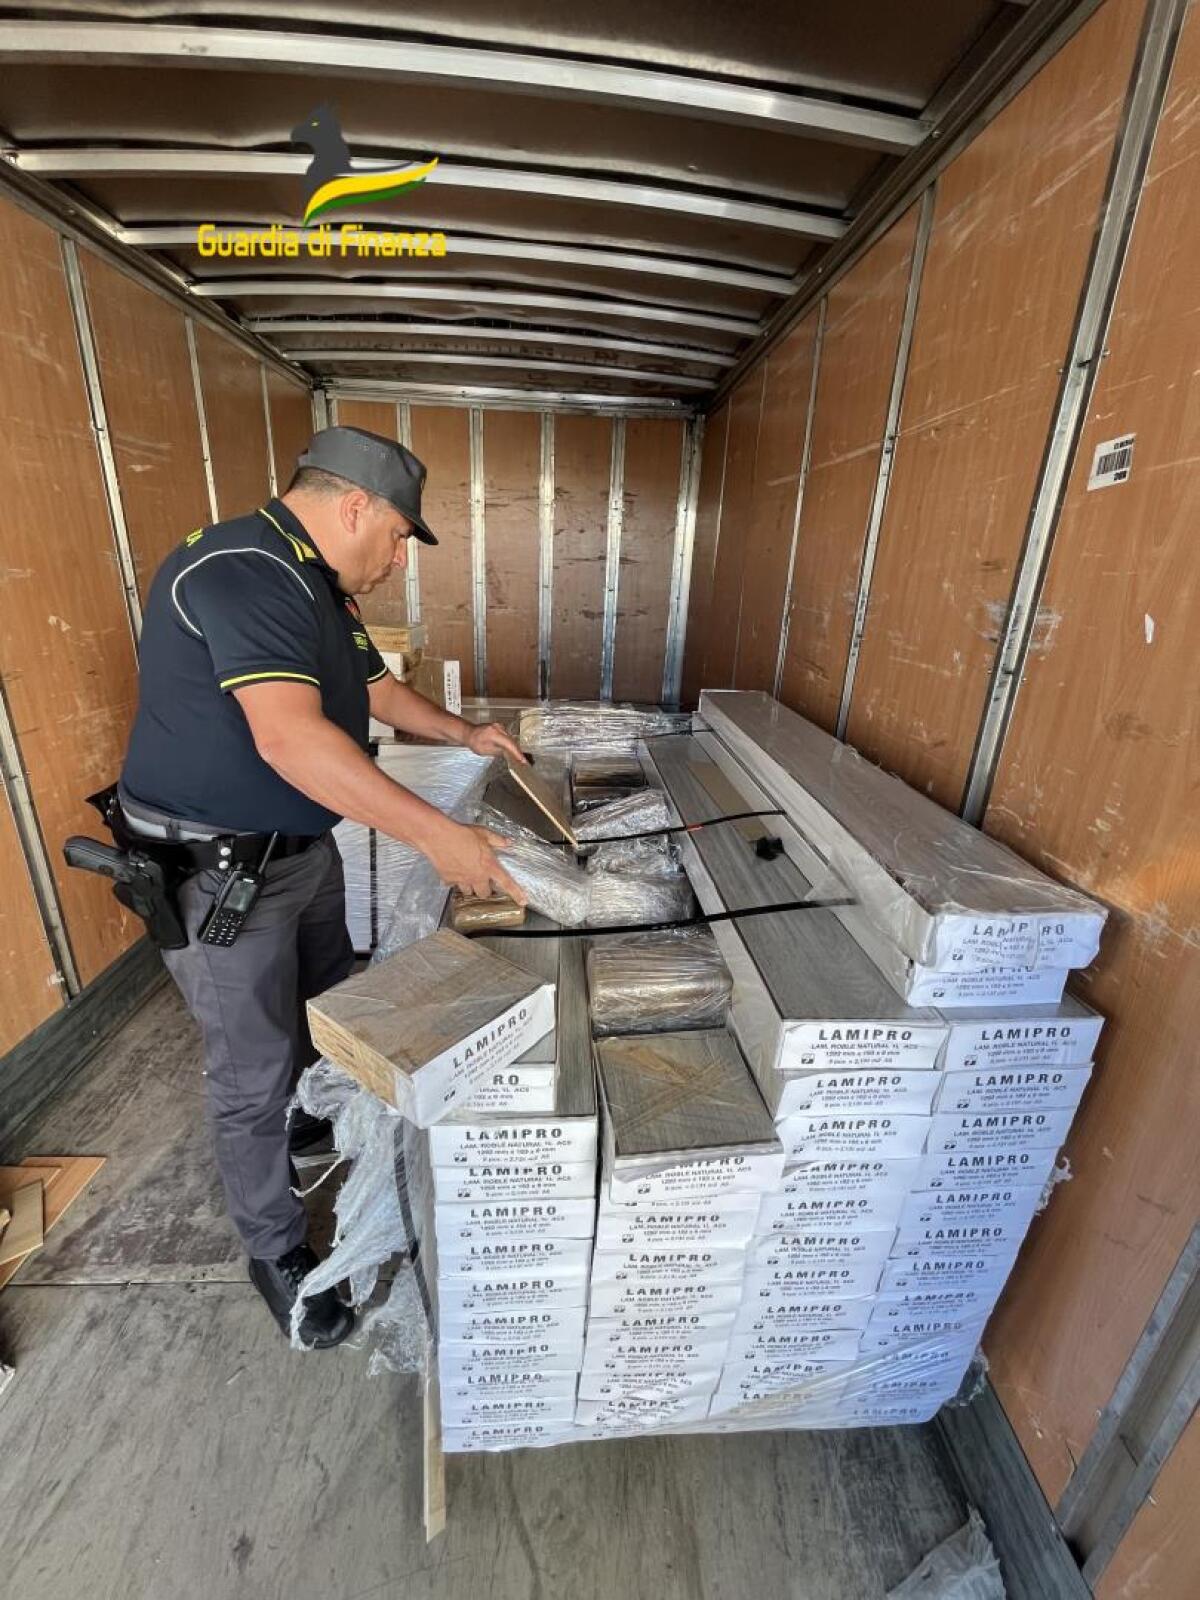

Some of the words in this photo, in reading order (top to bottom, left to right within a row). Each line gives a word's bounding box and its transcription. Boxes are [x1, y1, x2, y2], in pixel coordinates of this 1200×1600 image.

[453, 1008, 527, 1069] LAMIPRO
[818, 1029, 912, 1041] LAMIPRO
[981, 1027, 1071, 1041] LAMIPRO
[816, 1076, 901, 1088] LAMIPRO
[975, 1073, 1063, 1087] LAMIPRO
[808, 1119, 891, 1133] LAMIPRO
[962, 1115, 1046, 1128] LAMIPRO
[465, 1128, 562, 1141] LAMIPRO
[947, 1153, 1029, 1167] LAMIPRO
[469, 1165, 562, 1177] LAMIPRO
[800, 1162, 883, 1173] AMIPRO
[935, 1192, 1012, 1204] LAMIPRO
[787, 1199, 868, 1210] LAMIPRO
[470, 1206, 556, 1218] LAMIPRO
[635, 1214, 720, 1223] LAMIPRO
[925, 1227, 1003, 1239] LAMIPRO
[781, 1236, 861, 1246] LAMIPRO
[470, 1243, 555, 1255] LAMIPRO
[629, 1253, 712, 1263] LAMIPRO
[913, 1260, 985, 1271] LAMIPRO
[774, 1269, 850, 1279] LAMIPRO
[473, 1279, 554, 1292] LAMIPRO
[626, 1284, 706, 1296] LAMIPRO
[766, 1304, 842, 1313] LAMIPRO
[472, 1314, 551, 1325] LAMIPRO
[622, 1316, 700, 1327] LAMIPRO
[893, 1322, 963, 1333] LAMIPRO
[758, 1335, 831, 1343] LAMIPRO
[472, 1344, 549, 1357] LAMIPRO
[618, 1344, 693, 1353] LAMIPRO
[467, 1373, 543, 1384] LAMIPRO
[472, 1402, 545, 1411] LAMIPRO
[472, 1426, 544, 1437] LAMIPRO
